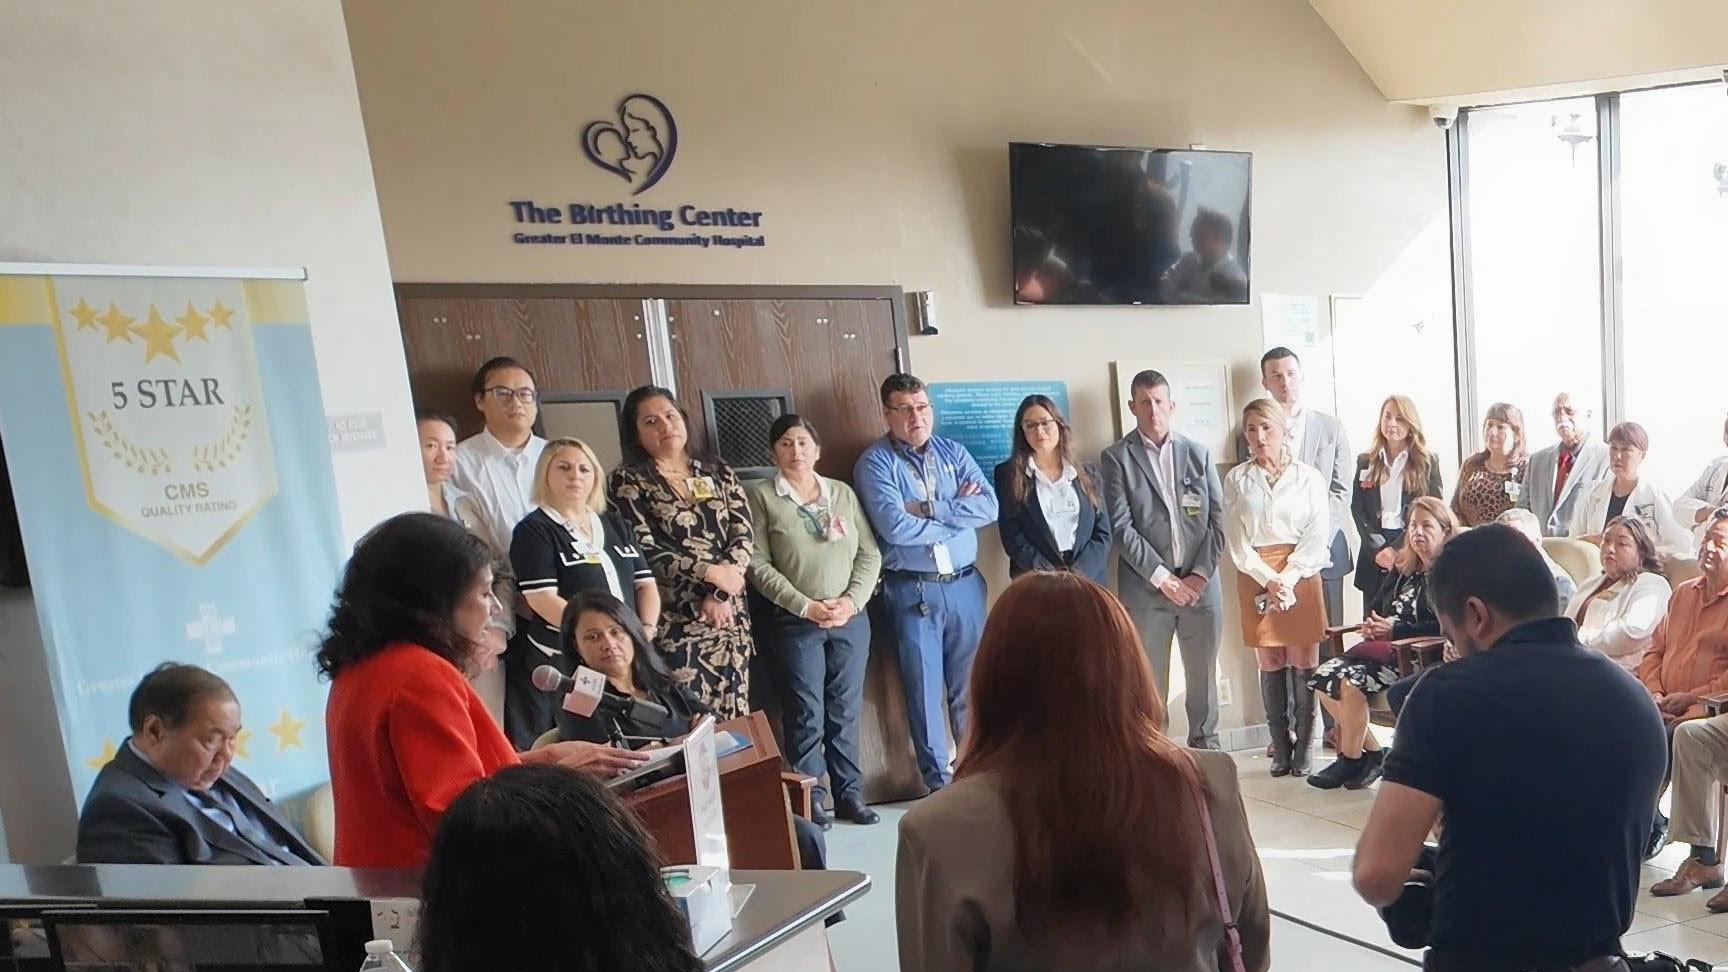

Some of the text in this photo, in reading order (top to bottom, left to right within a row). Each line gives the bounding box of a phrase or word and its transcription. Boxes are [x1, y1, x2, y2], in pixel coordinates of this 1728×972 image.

[509, 200, 763, 231] The Birthing Center
[513, 232, 766, 248] Greater El Monte Community Hospital
[111, 377, 225, 410] 5 STAR
[164, 482, 210, 500] CMS
[141, 500, 238, 517] QUALITY RATING
